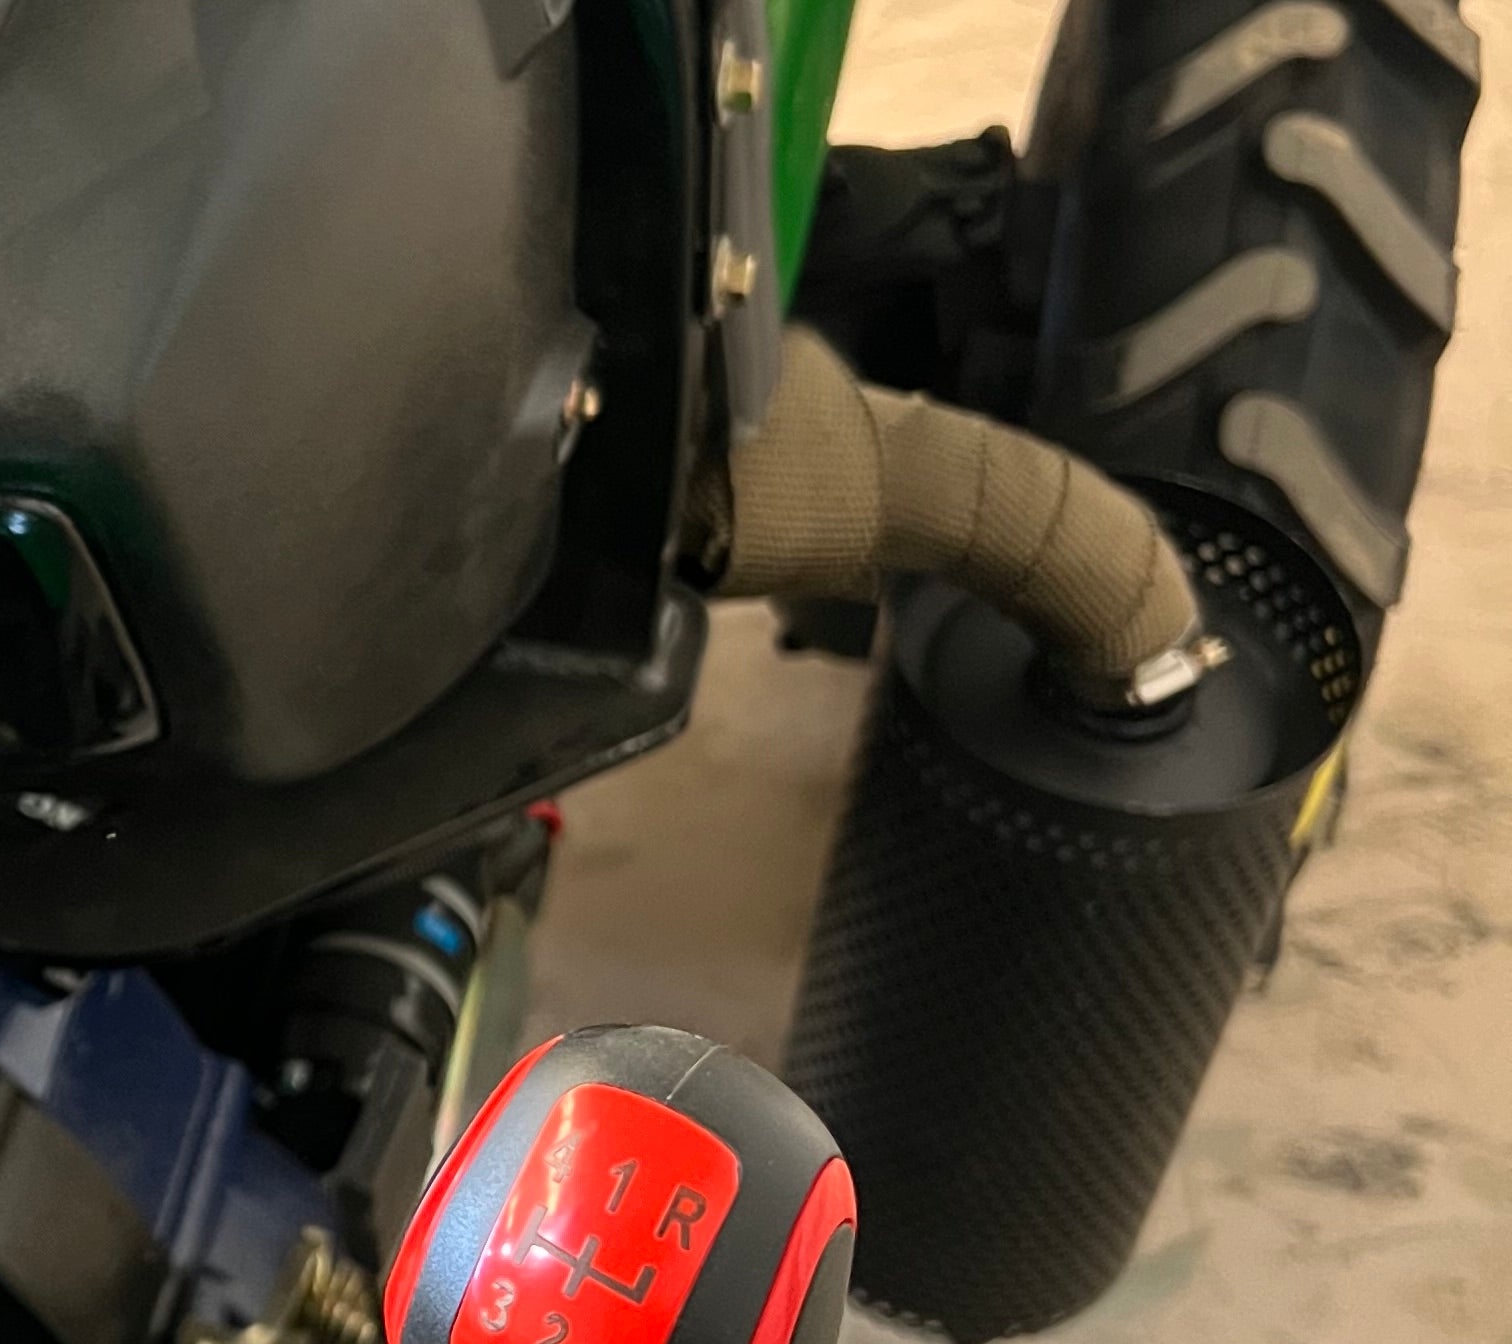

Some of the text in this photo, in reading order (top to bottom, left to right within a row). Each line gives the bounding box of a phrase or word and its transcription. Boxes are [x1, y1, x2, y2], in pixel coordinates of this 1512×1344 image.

[545, 1133, 706, 1251] 4 1 R
[480, 1281, 515, 1332] 3
